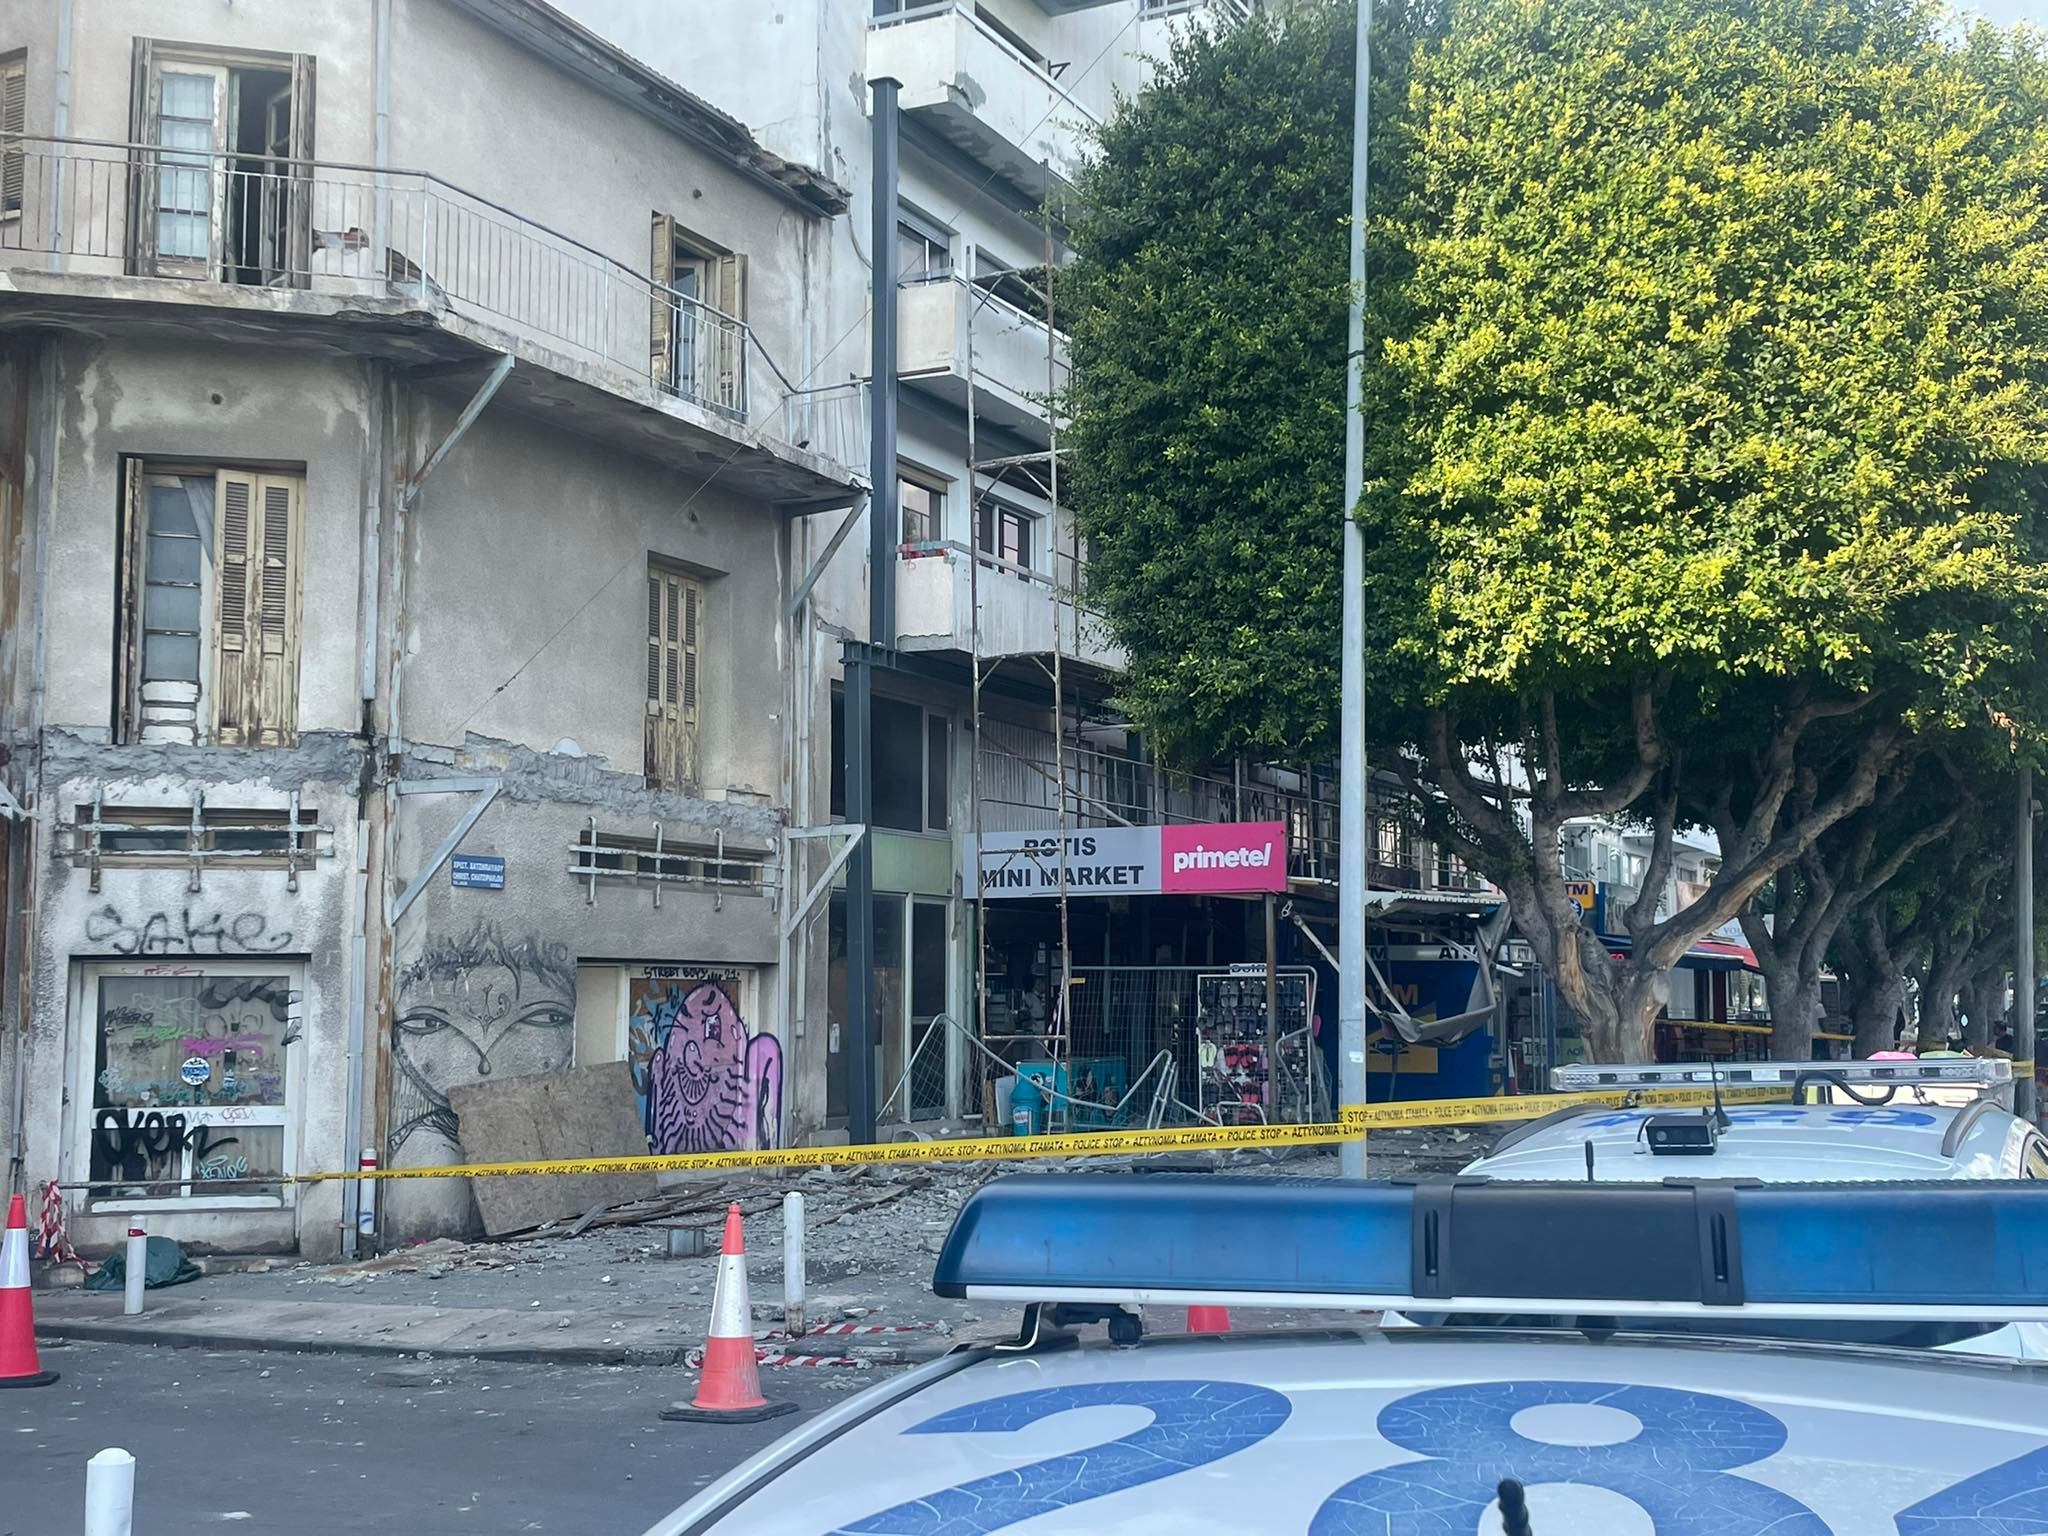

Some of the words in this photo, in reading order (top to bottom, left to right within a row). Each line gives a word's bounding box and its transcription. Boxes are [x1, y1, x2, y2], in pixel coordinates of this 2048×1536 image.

[1173, 842, 1273, 873] primetel
[982, 868, 1031, 888] MINI
[1040, 865, 1144, 888] MARKET
[1564, 883, 1589, 896] TM
[1348, 1110, 1368, 1123] STOP
[793, 1153, 818, 1164] POLICE
[820, 1152, 839, 1163] STOP
[928, 1146, 955, 1157] POLICE
[957, 1145, 977, 1156] STOP
[1072, 1138, 1101, 1150] POLICE
[1103, 1137, 1124, 1148] STOP
[1226, 1129, 1256, 1141] POLICE
[1259, 1127, 1282, 1140] STOP
